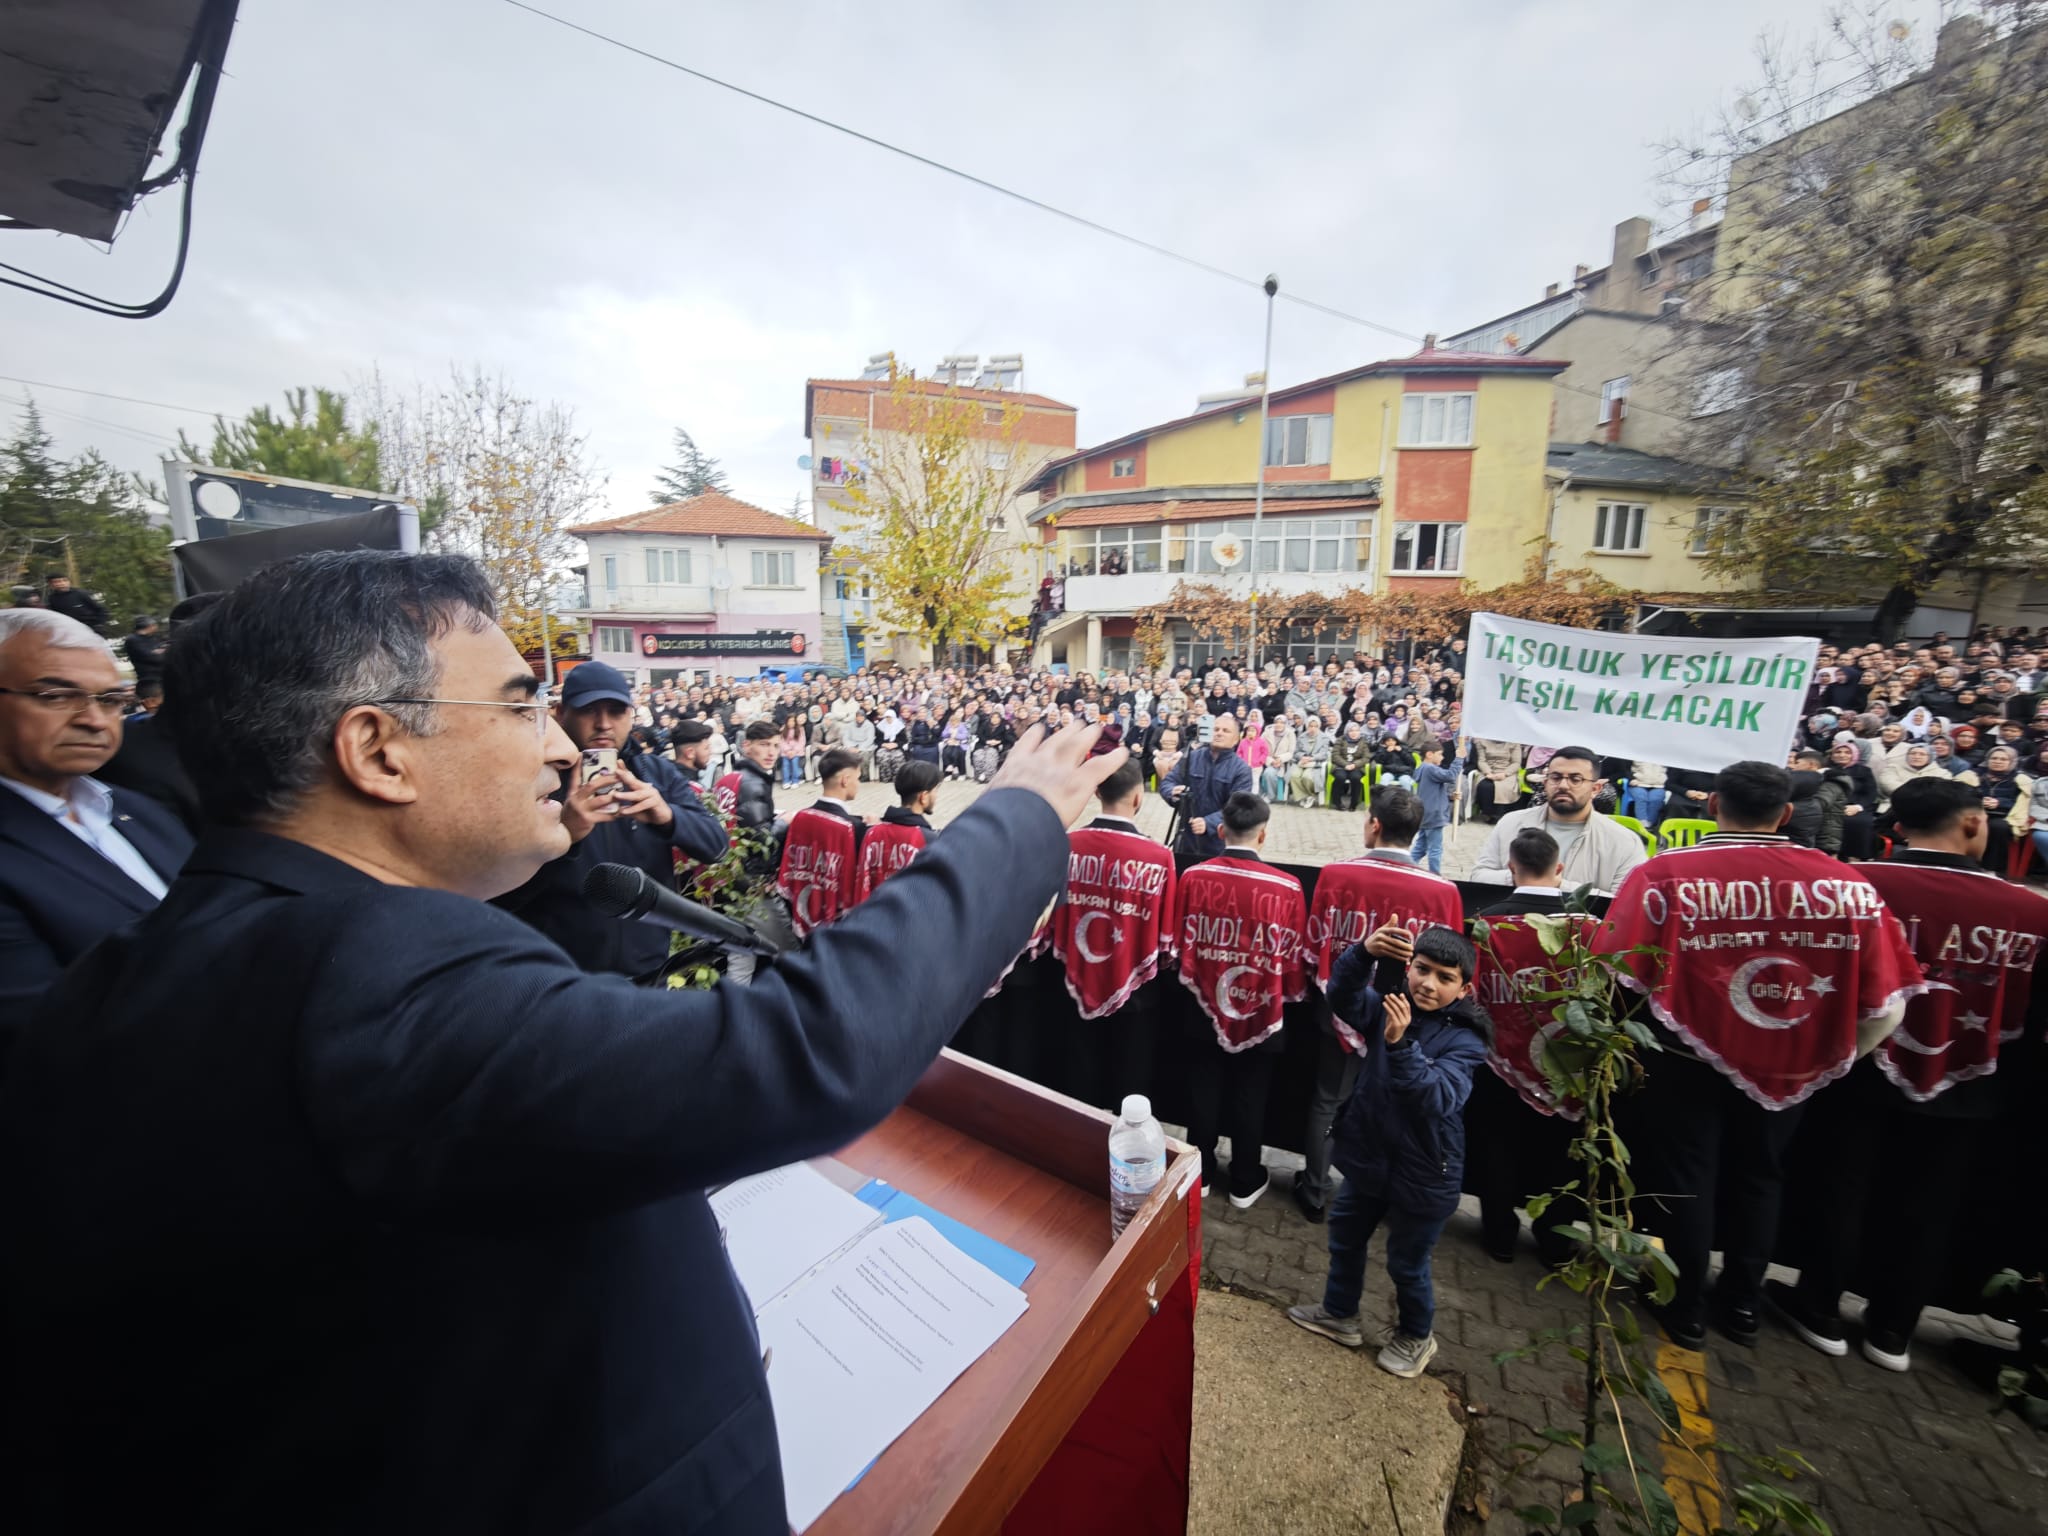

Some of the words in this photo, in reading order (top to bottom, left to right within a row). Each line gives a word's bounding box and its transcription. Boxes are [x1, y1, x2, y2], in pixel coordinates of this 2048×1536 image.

[1484, 632, 1627, 677] TAŞOLUK
[1641, 650, 1807, 690] YEŞİLDİR
[1498, 673, 1579, 713] YEŞİL
[1593, 687, 1768, 732] KALACAK
[1678, 875, 1777, 932] ŞİMDİ
[1184, 911, 1243, 950] ŞİMDİ
[1677, 930, 1770, 952] MURAT
[1196, 946, 1251, 965] MURAT
[1229, 986, 1258, 1002] 06/1
[1750, 981, 1805, 1003] 06/1
